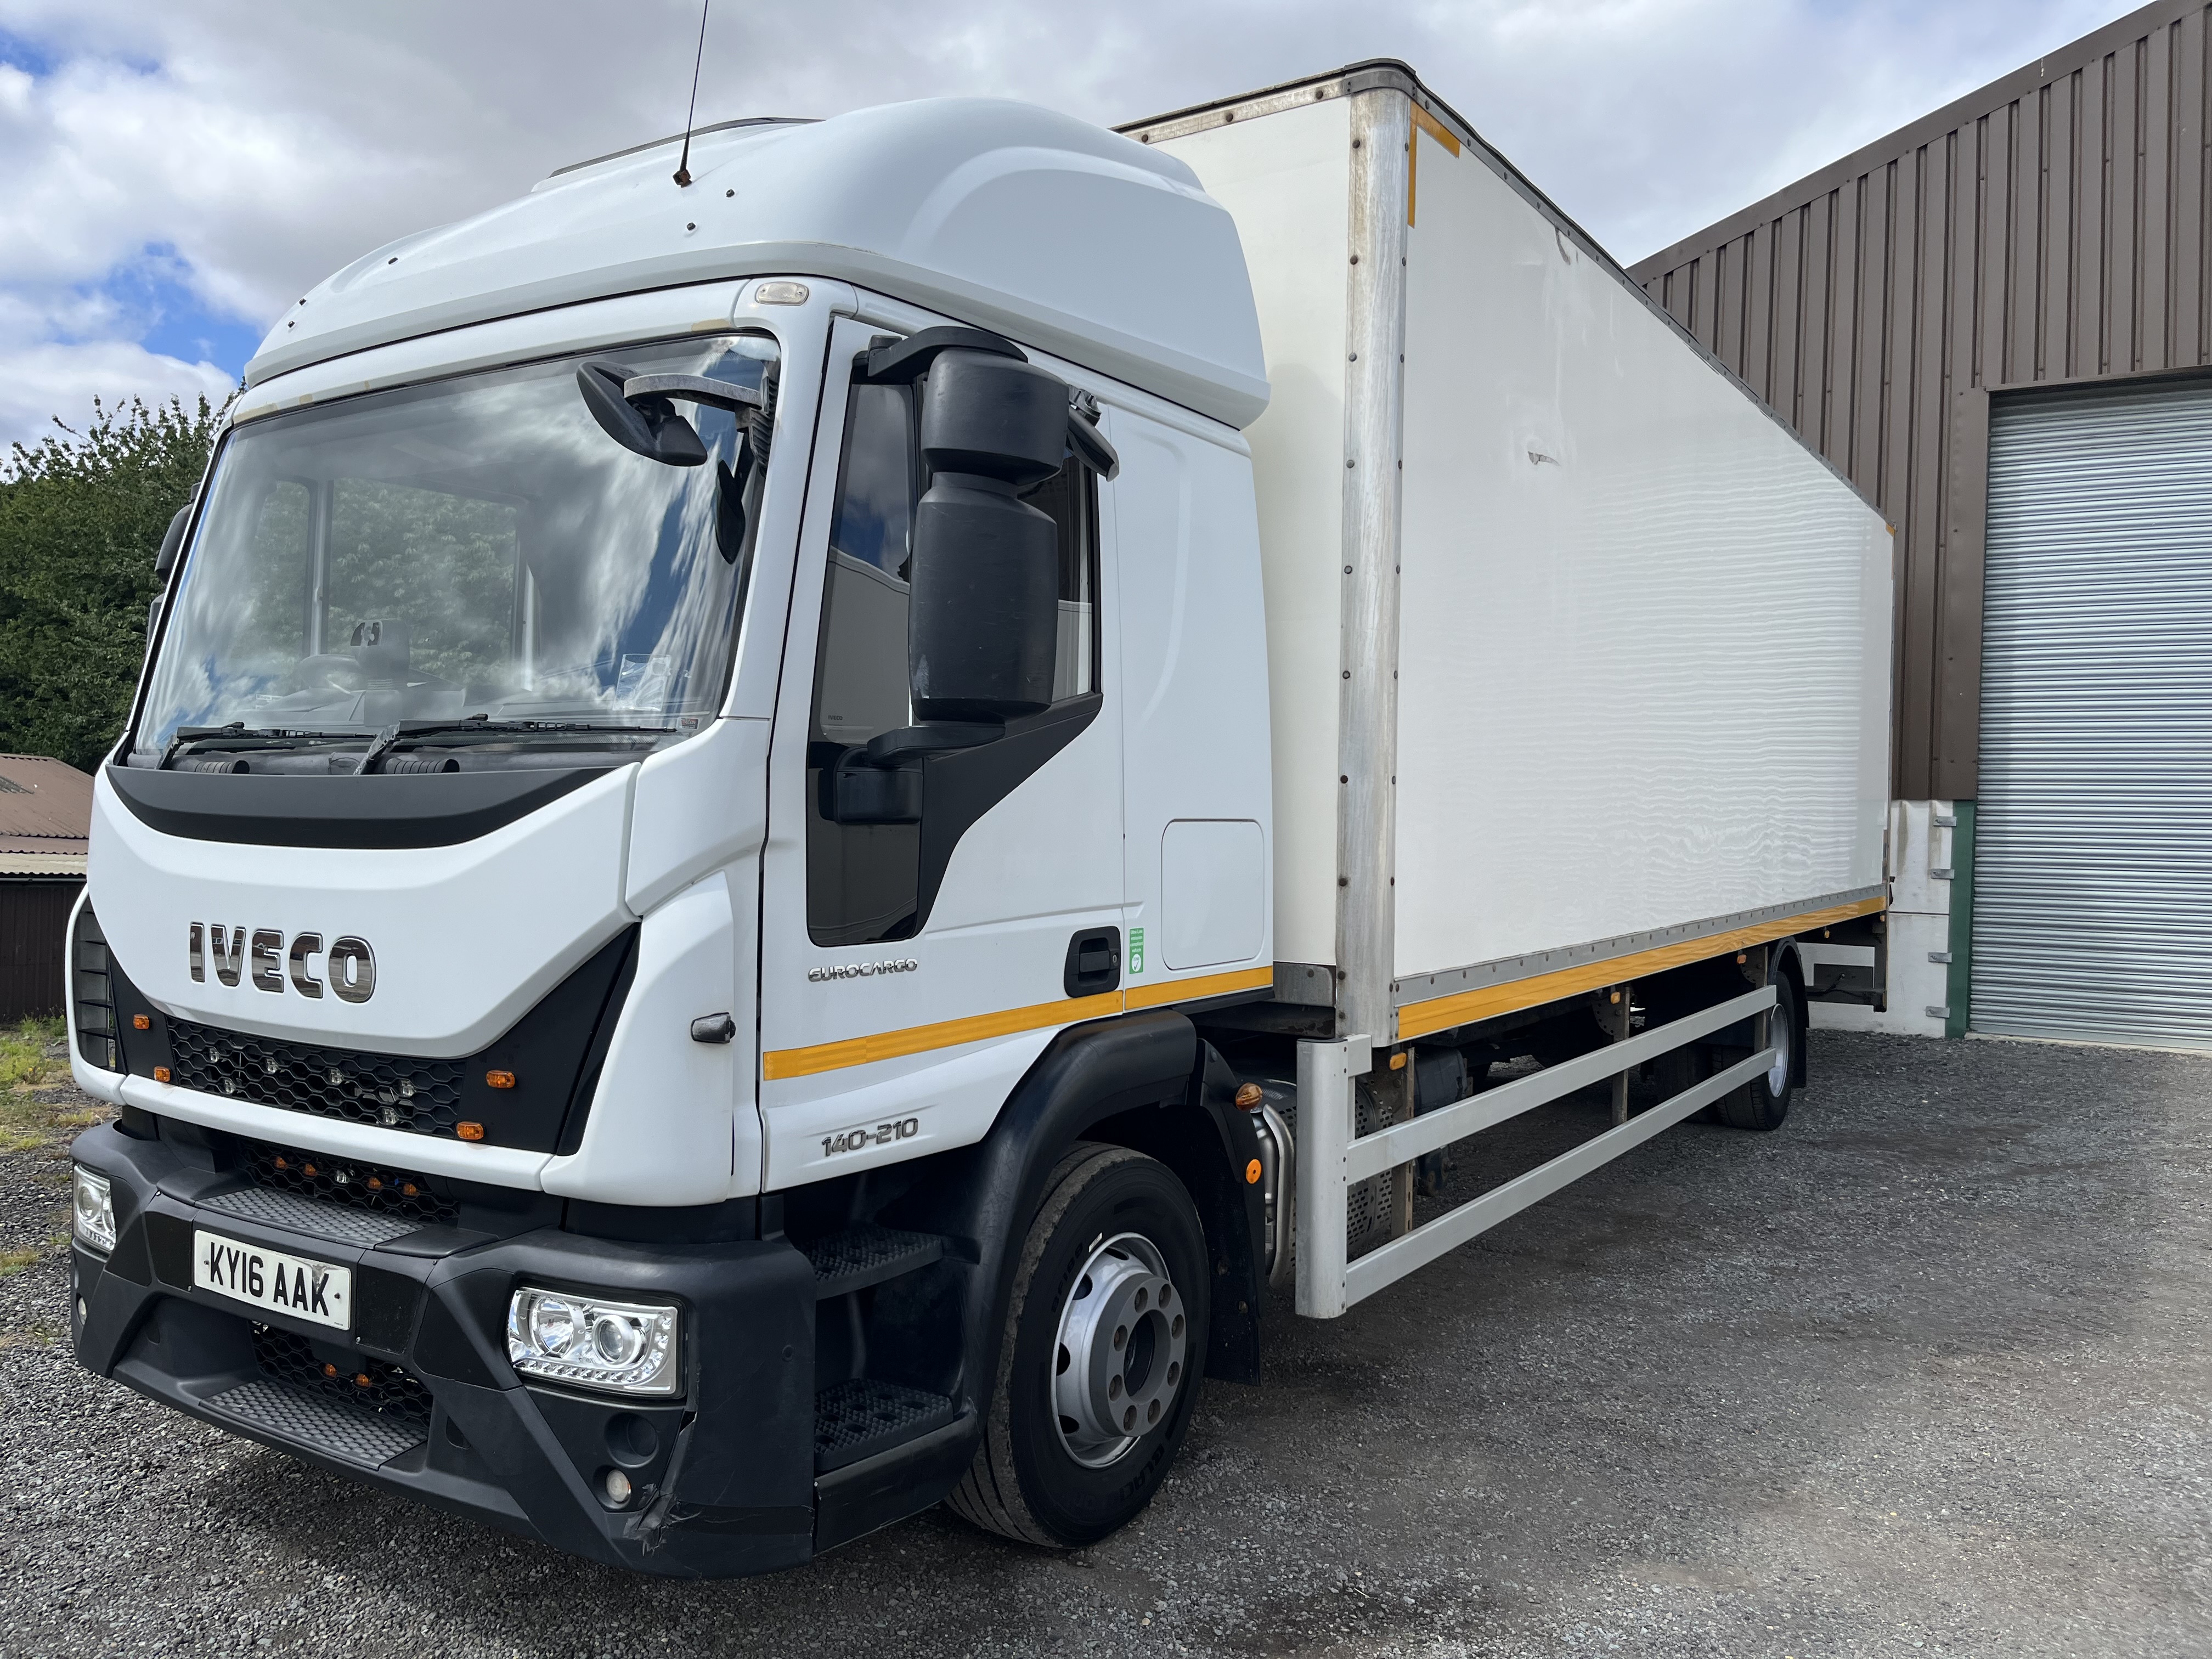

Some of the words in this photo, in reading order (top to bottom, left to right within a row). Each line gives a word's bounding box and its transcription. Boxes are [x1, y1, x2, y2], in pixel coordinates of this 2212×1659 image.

[190, 922, 376, 1003] IVECO
[808, 958, 918, 982] EUROCARGO
[821, 1118, 918, 1157] 140-210
[211, 1242, 263, 1298] KY16
[273, 1262, 329, 1317] AAK
